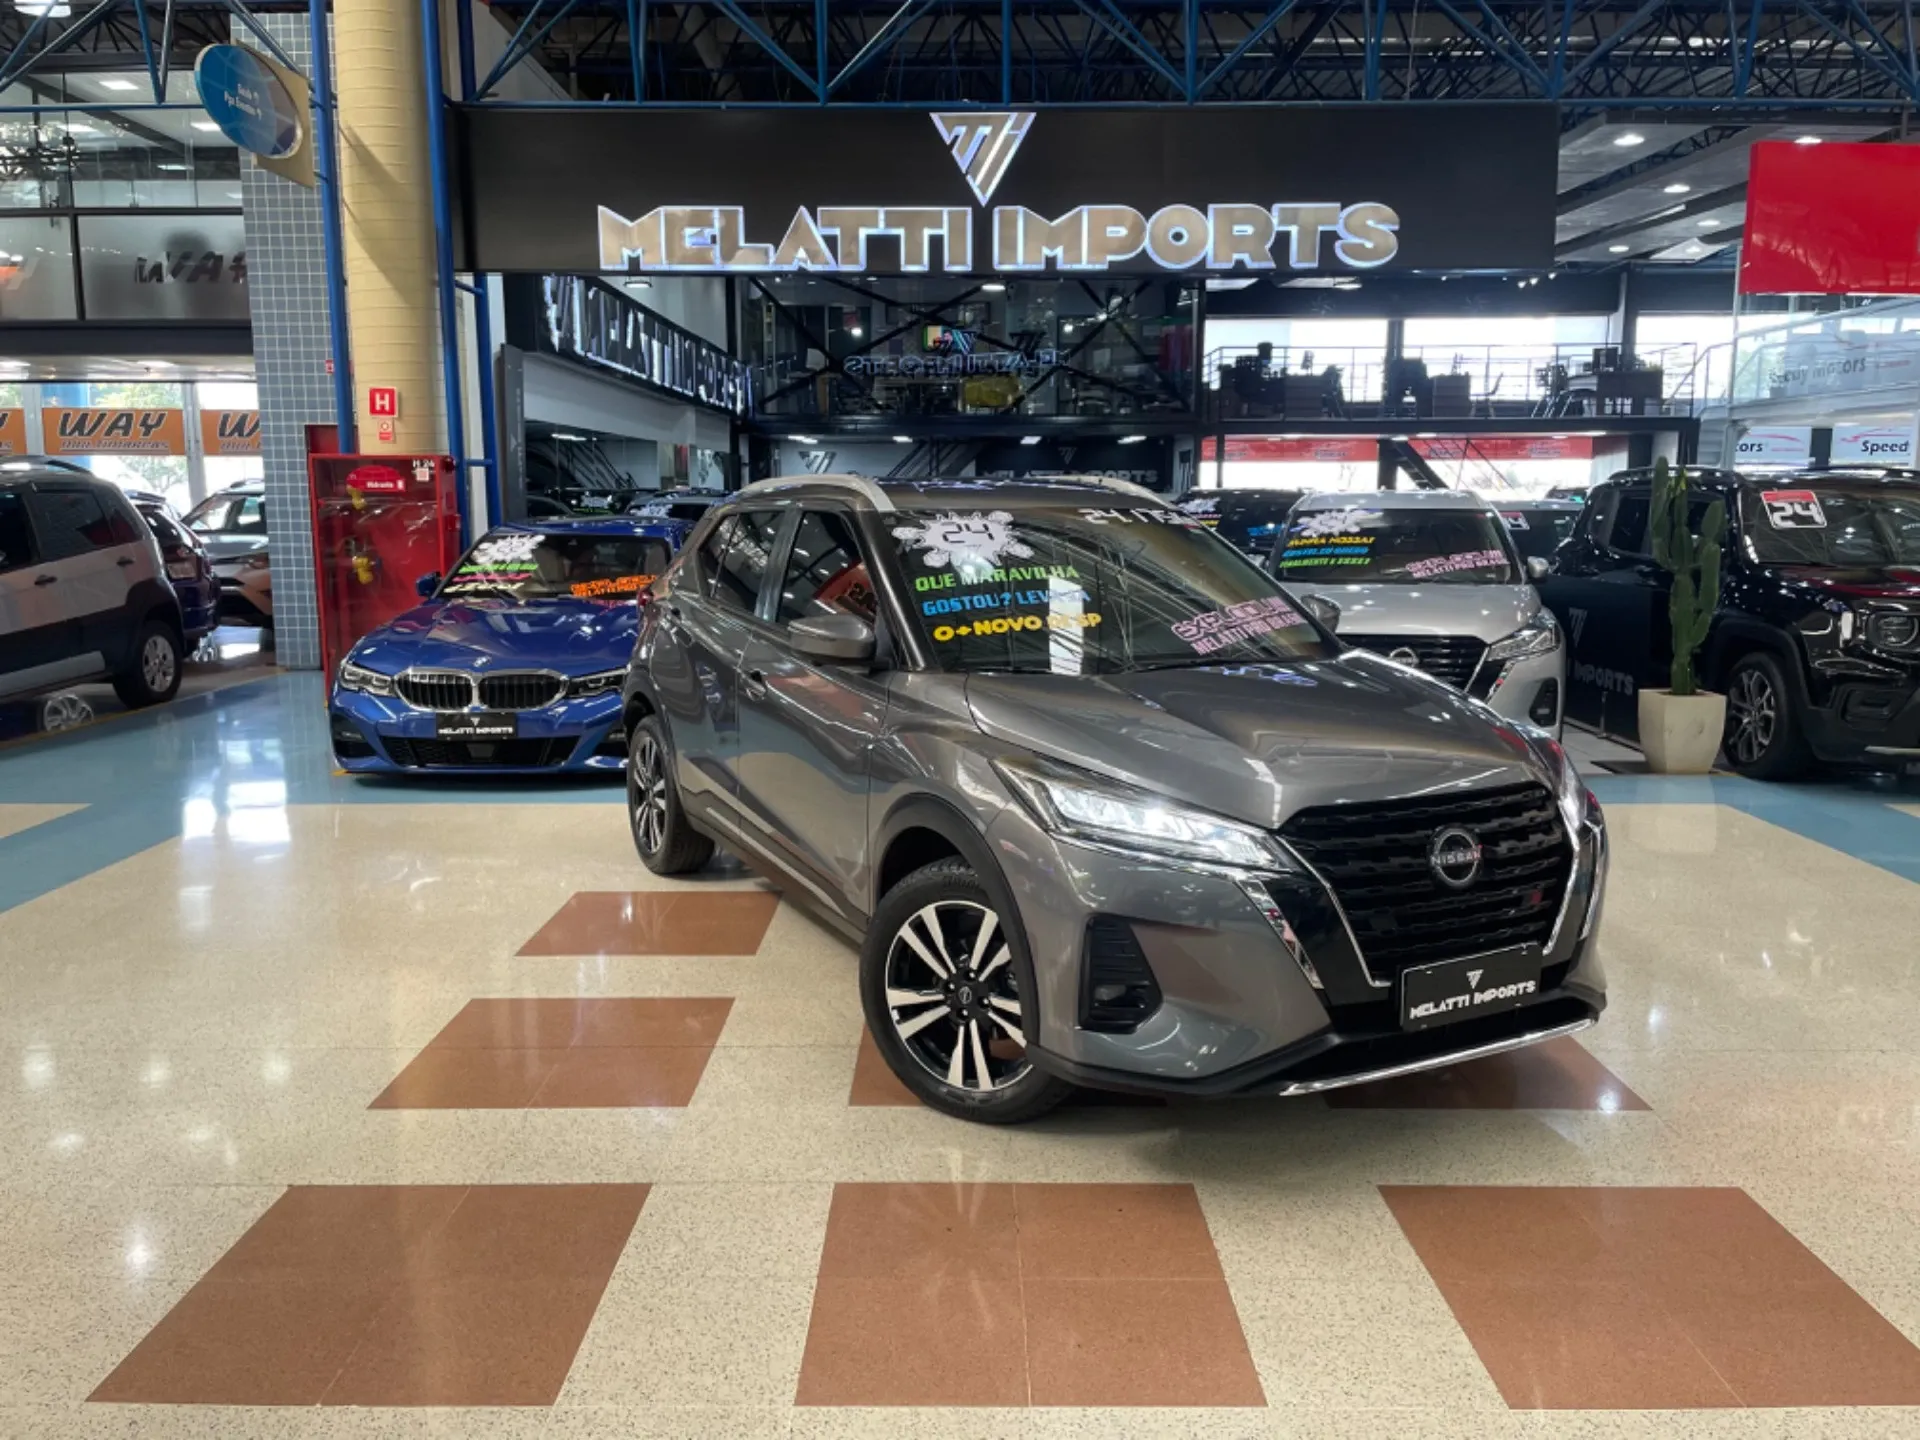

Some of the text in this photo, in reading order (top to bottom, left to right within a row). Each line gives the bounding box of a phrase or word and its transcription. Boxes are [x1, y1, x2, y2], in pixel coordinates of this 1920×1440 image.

[597, 203, 1400, 272] MELATTI IMPORTS
[374, 392, 390, 412] H
[58, 411, 168, 439] WAY
[1771, 503, 1823, 528] 24
[941, 521, 995, 544] 24
[915, 566, 1079, 592] QUE MARAVILHA
[1190, 627, 1248, 656] MELATTI
[1574, 660, 1634, 696] IMPORTS
[1431, 848, 1482, 866] NISSAN
[1409, 980, 1536, 1020] MELATTI IMPORTS
